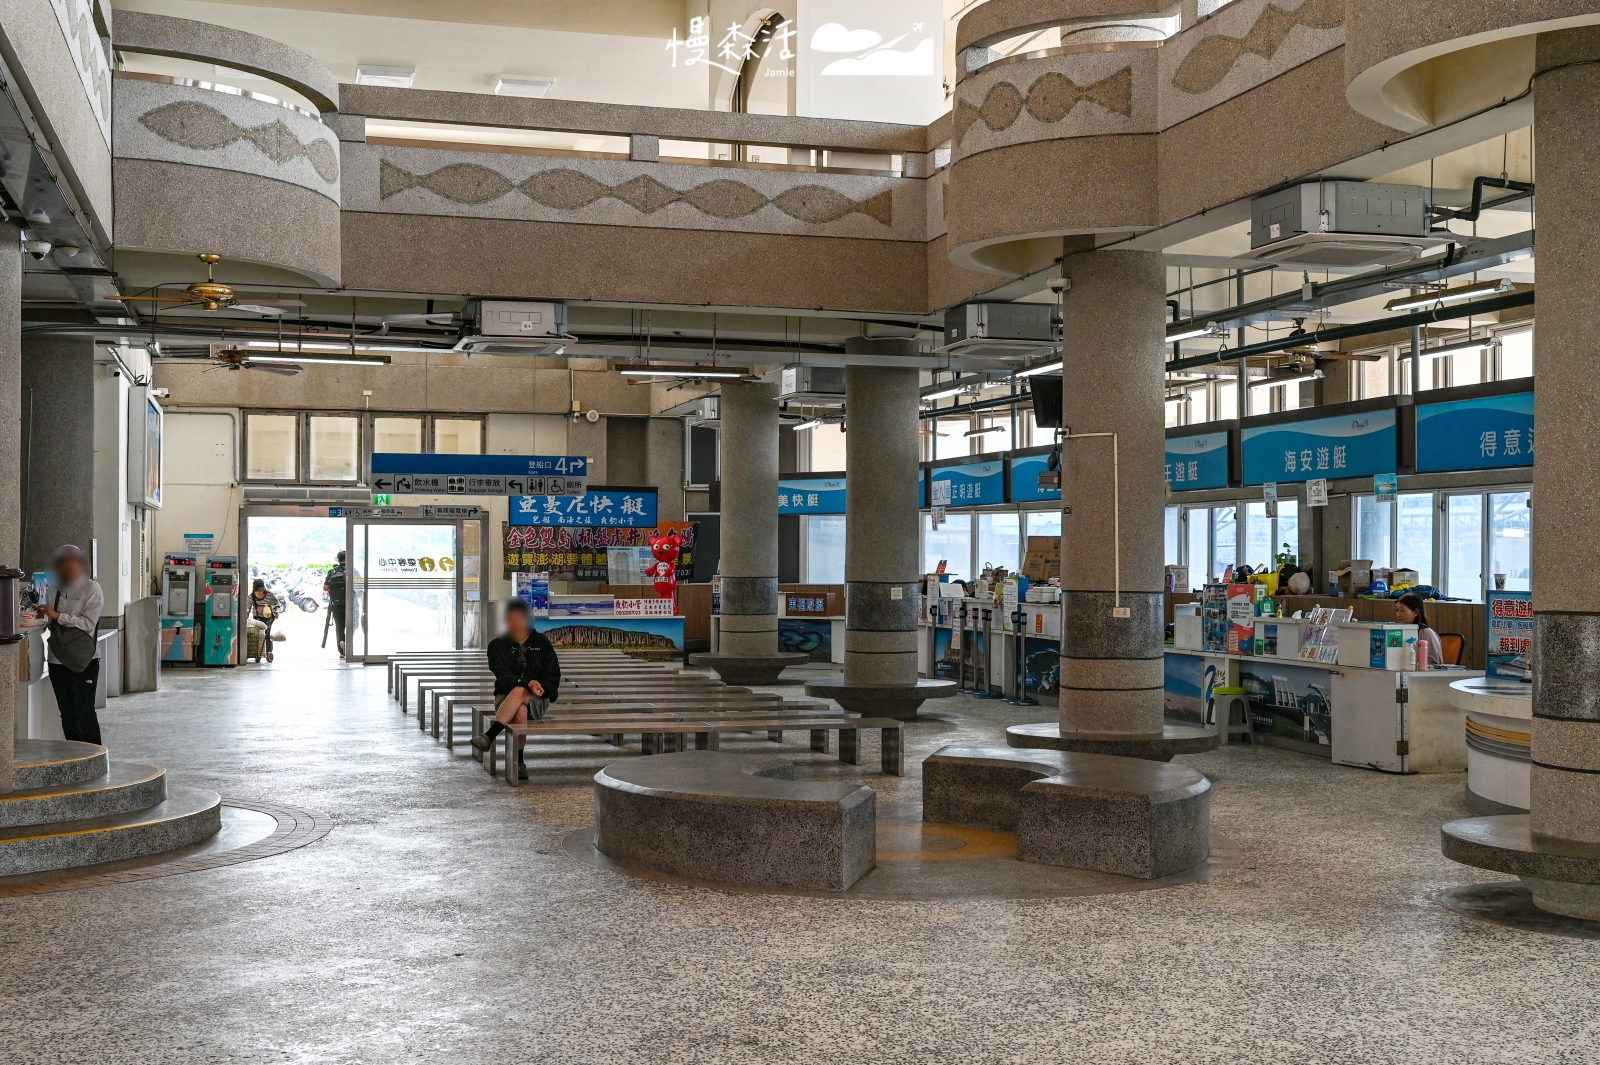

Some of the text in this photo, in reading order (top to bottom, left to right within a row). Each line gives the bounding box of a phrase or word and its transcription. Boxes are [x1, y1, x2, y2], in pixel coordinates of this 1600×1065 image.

[528, 457, 568, 474] 登船口 4
[1284, 445, 1347, 473] 海安遊艇
[414, 478, 439, 487] 飲水機
[468, 478, 501, 487] 行李寄放
[566, 481, 582, 489] 廁所
[519, 495, 647, 516] 亞曼尼快艇
[778, 494, 819, 507] 美快艇
[337, 508, 342, 516] 3
[507, 527, 695, 549] 金色雙島(桶盤虎井)陽
[507, 552, 608, 567] 遊覽澎湖要體驗
